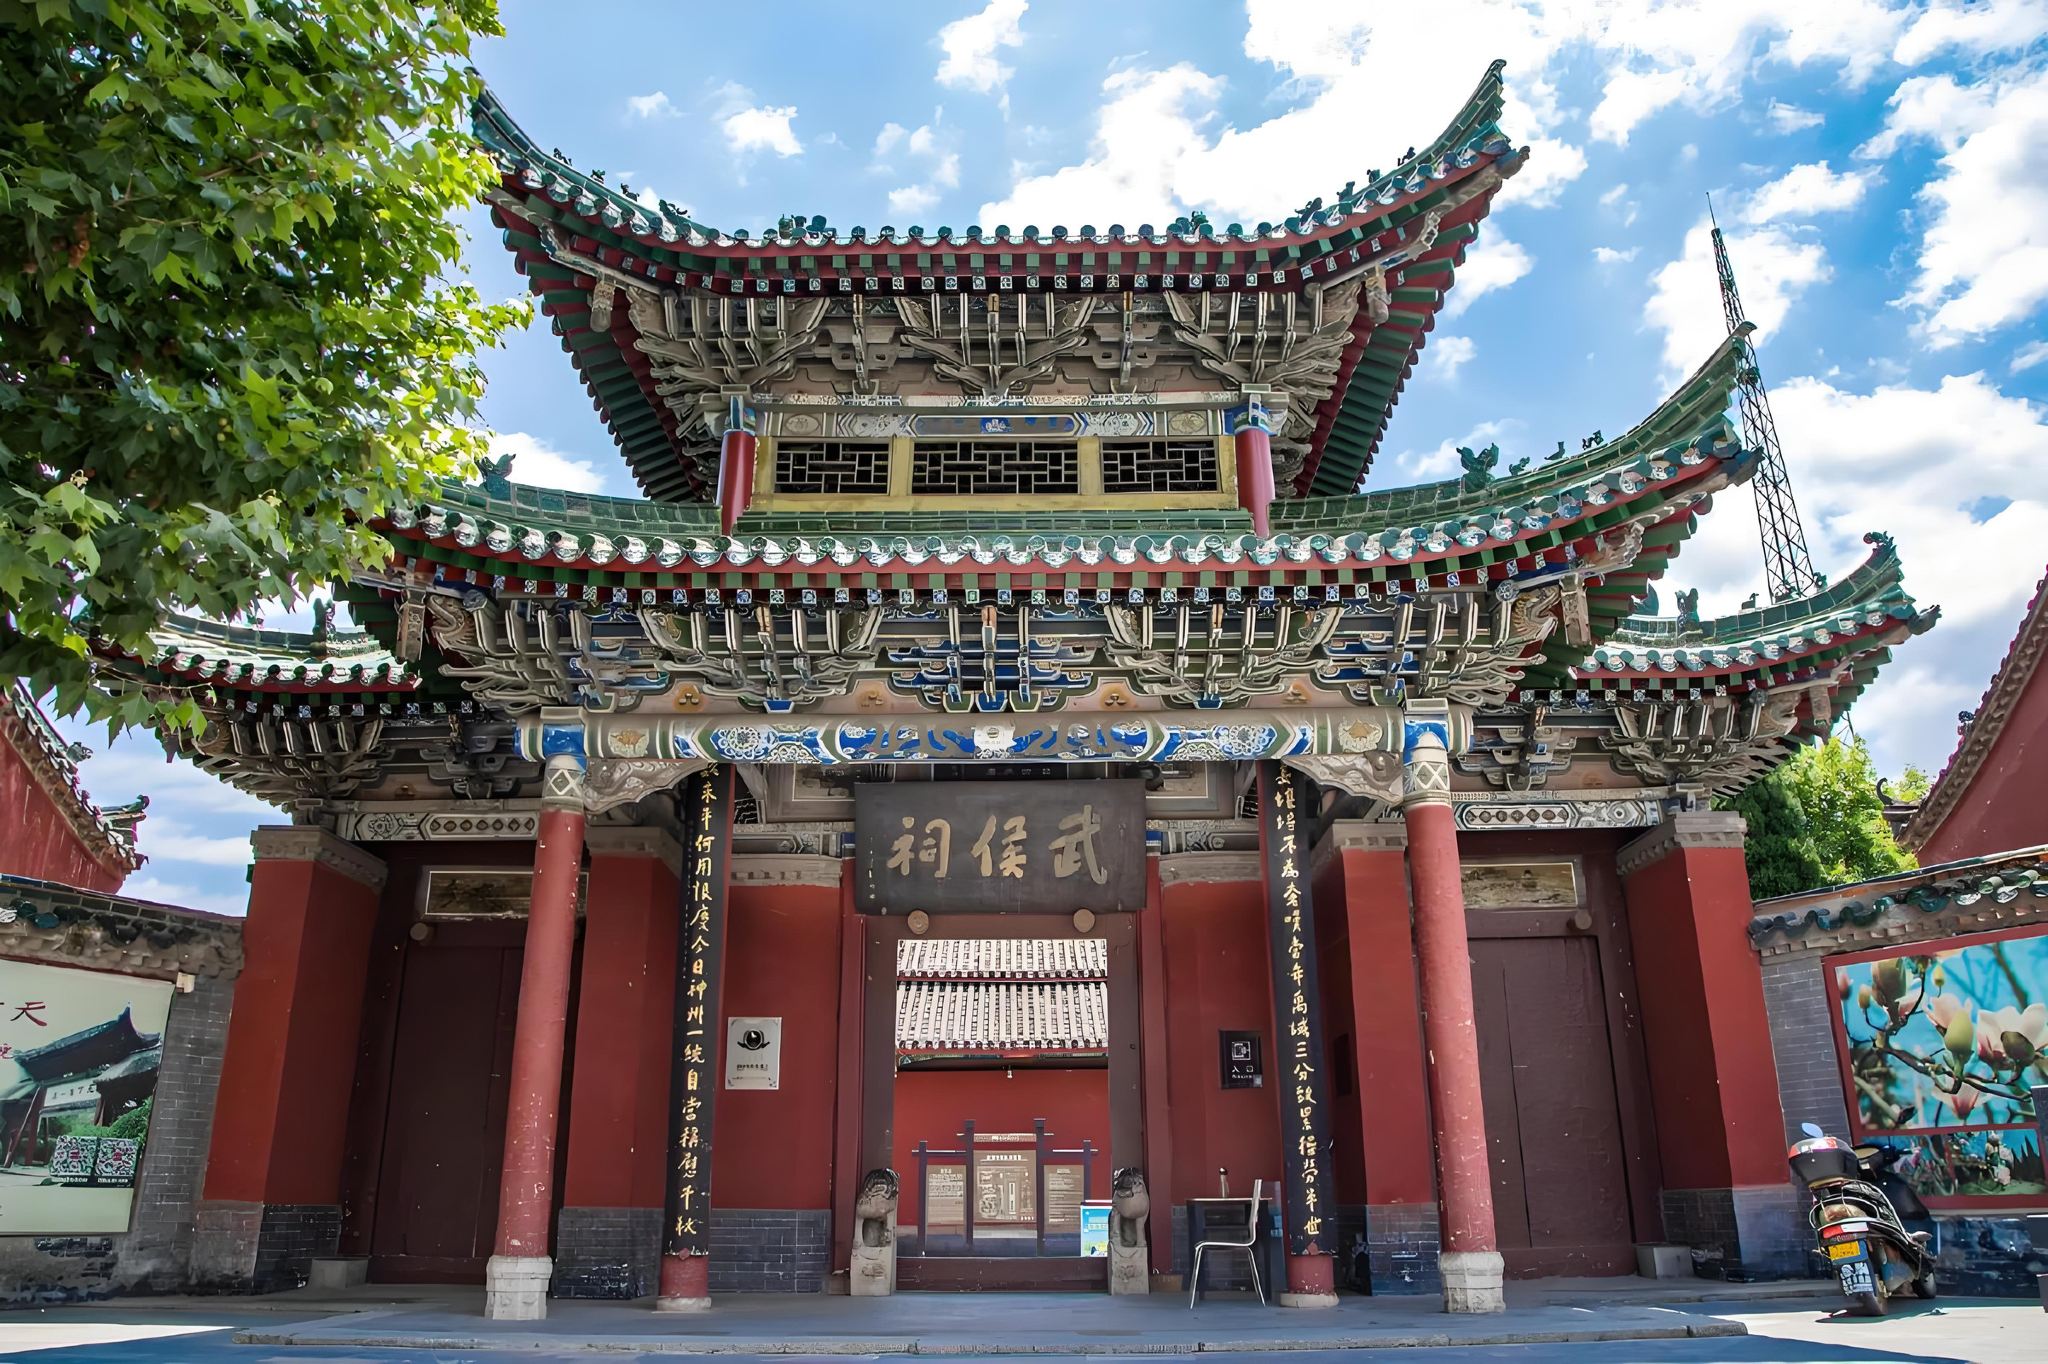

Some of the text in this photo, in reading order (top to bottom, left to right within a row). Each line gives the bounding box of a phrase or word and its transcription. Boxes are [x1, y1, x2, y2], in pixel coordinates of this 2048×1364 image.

[886, 804, 1108, 885] 武侯祠
[0, 1001, 48, 1027] 天
[1231, 1065, 1254, 1073] 入口
